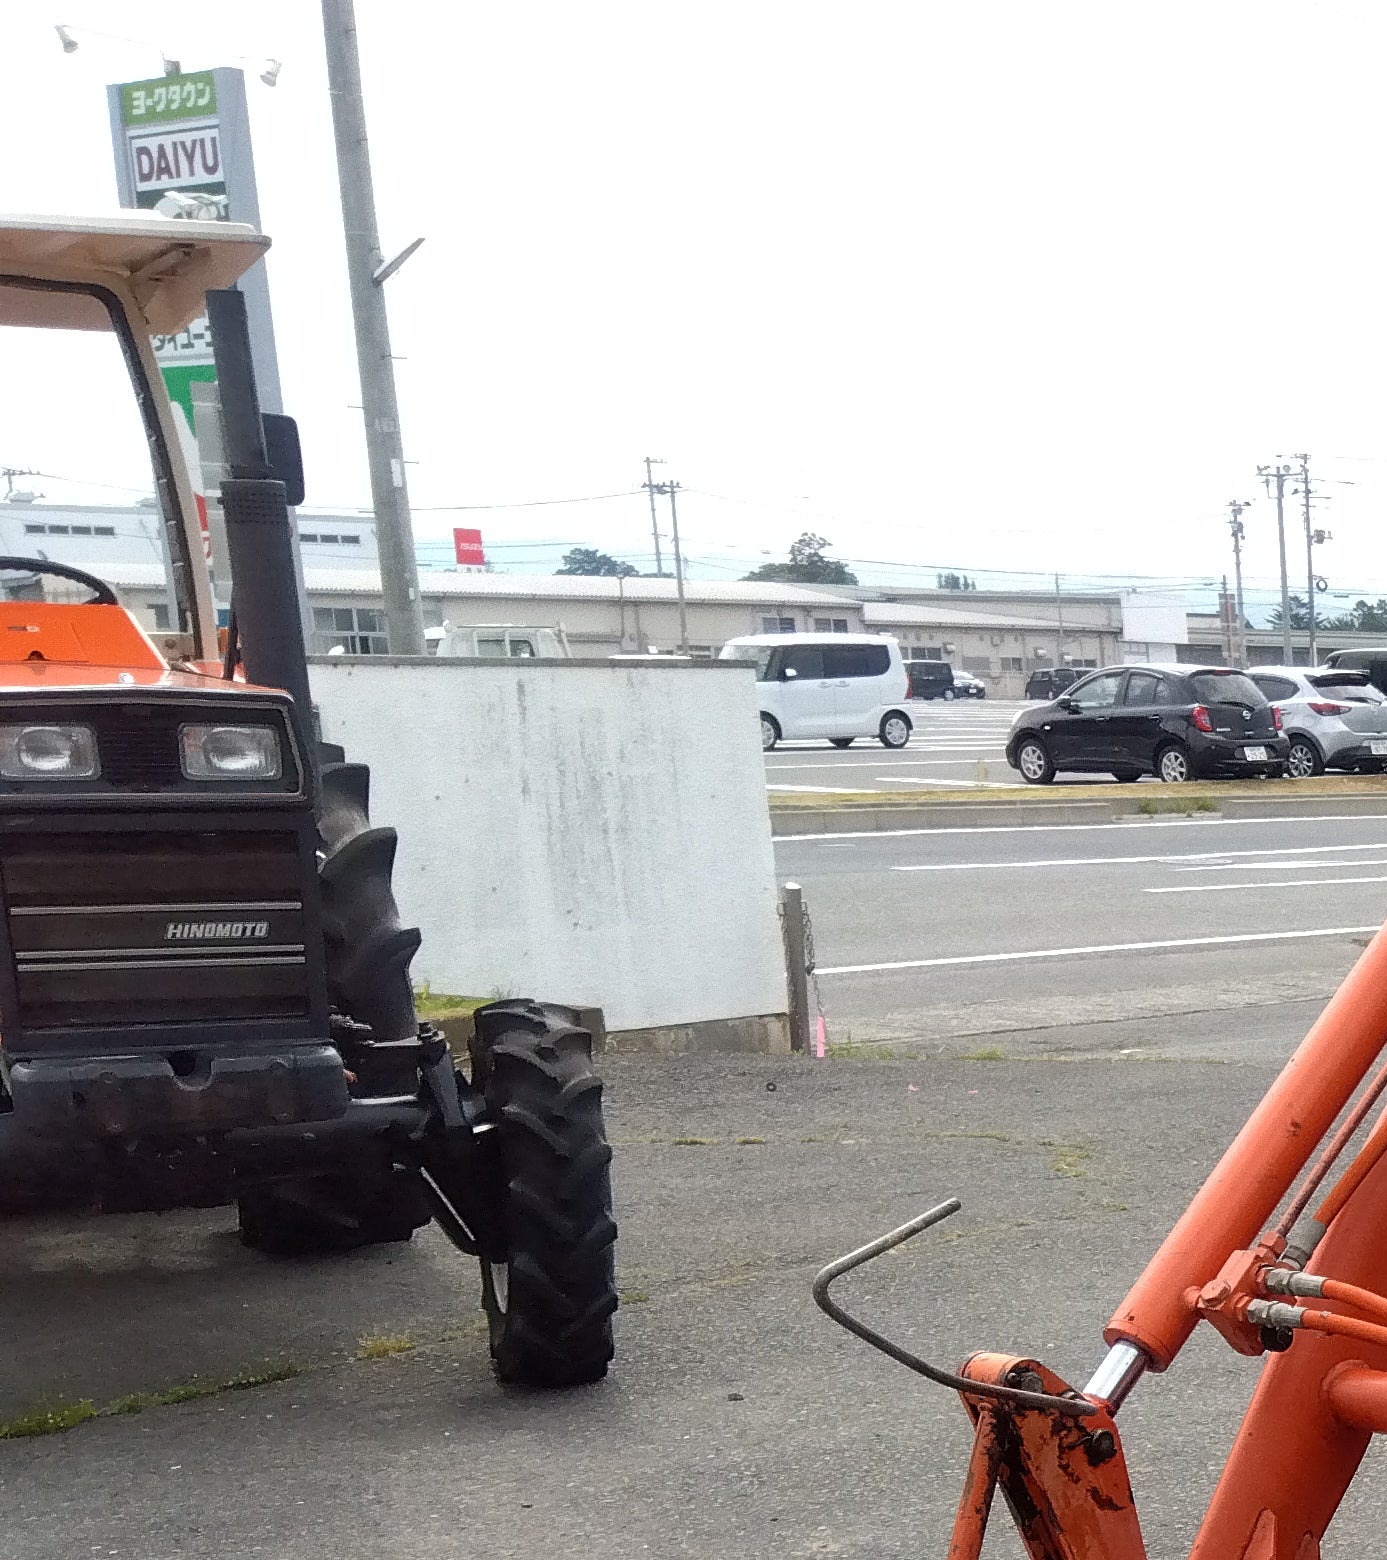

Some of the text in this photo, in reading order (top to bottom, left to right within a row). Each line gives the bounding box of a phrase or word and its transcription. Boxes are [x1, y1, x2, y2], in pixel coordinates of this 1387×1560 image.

[131, 82, 211, 115] ヨークタウン
[135, 136, 220, 183] DAIYU
[165, 921, 270, 939] HINOMOTO
